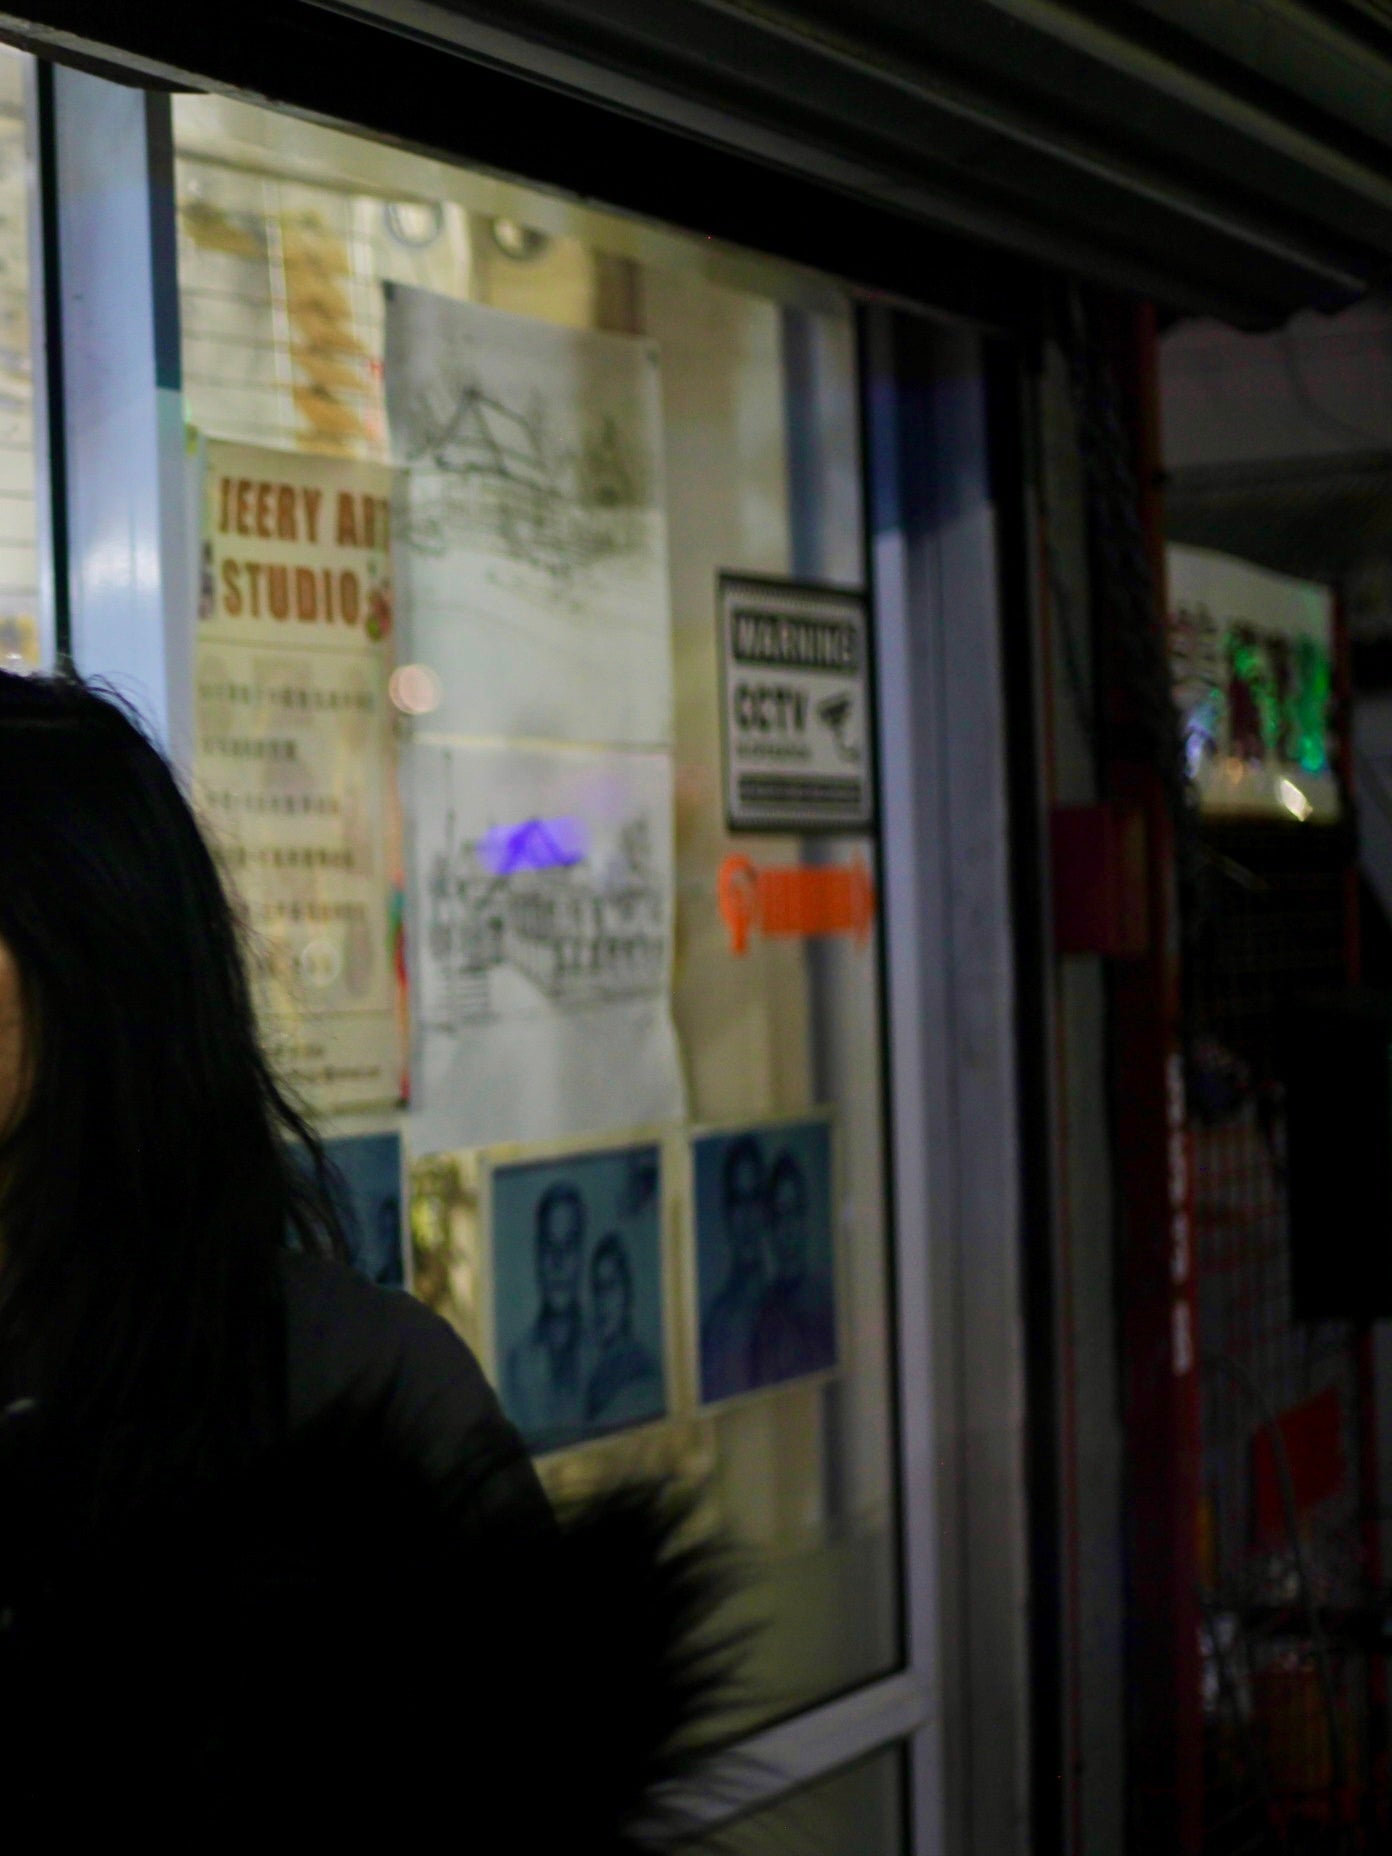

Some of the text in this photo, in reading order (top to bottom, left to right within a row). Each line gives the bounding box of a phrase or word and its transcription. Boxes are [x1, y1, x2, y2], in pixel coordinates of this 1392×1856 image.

[221, 556, 360, 626] STUDIO
[737, 612, 853, 665] WARNING
[735, 683, 808, 732] CCTV
